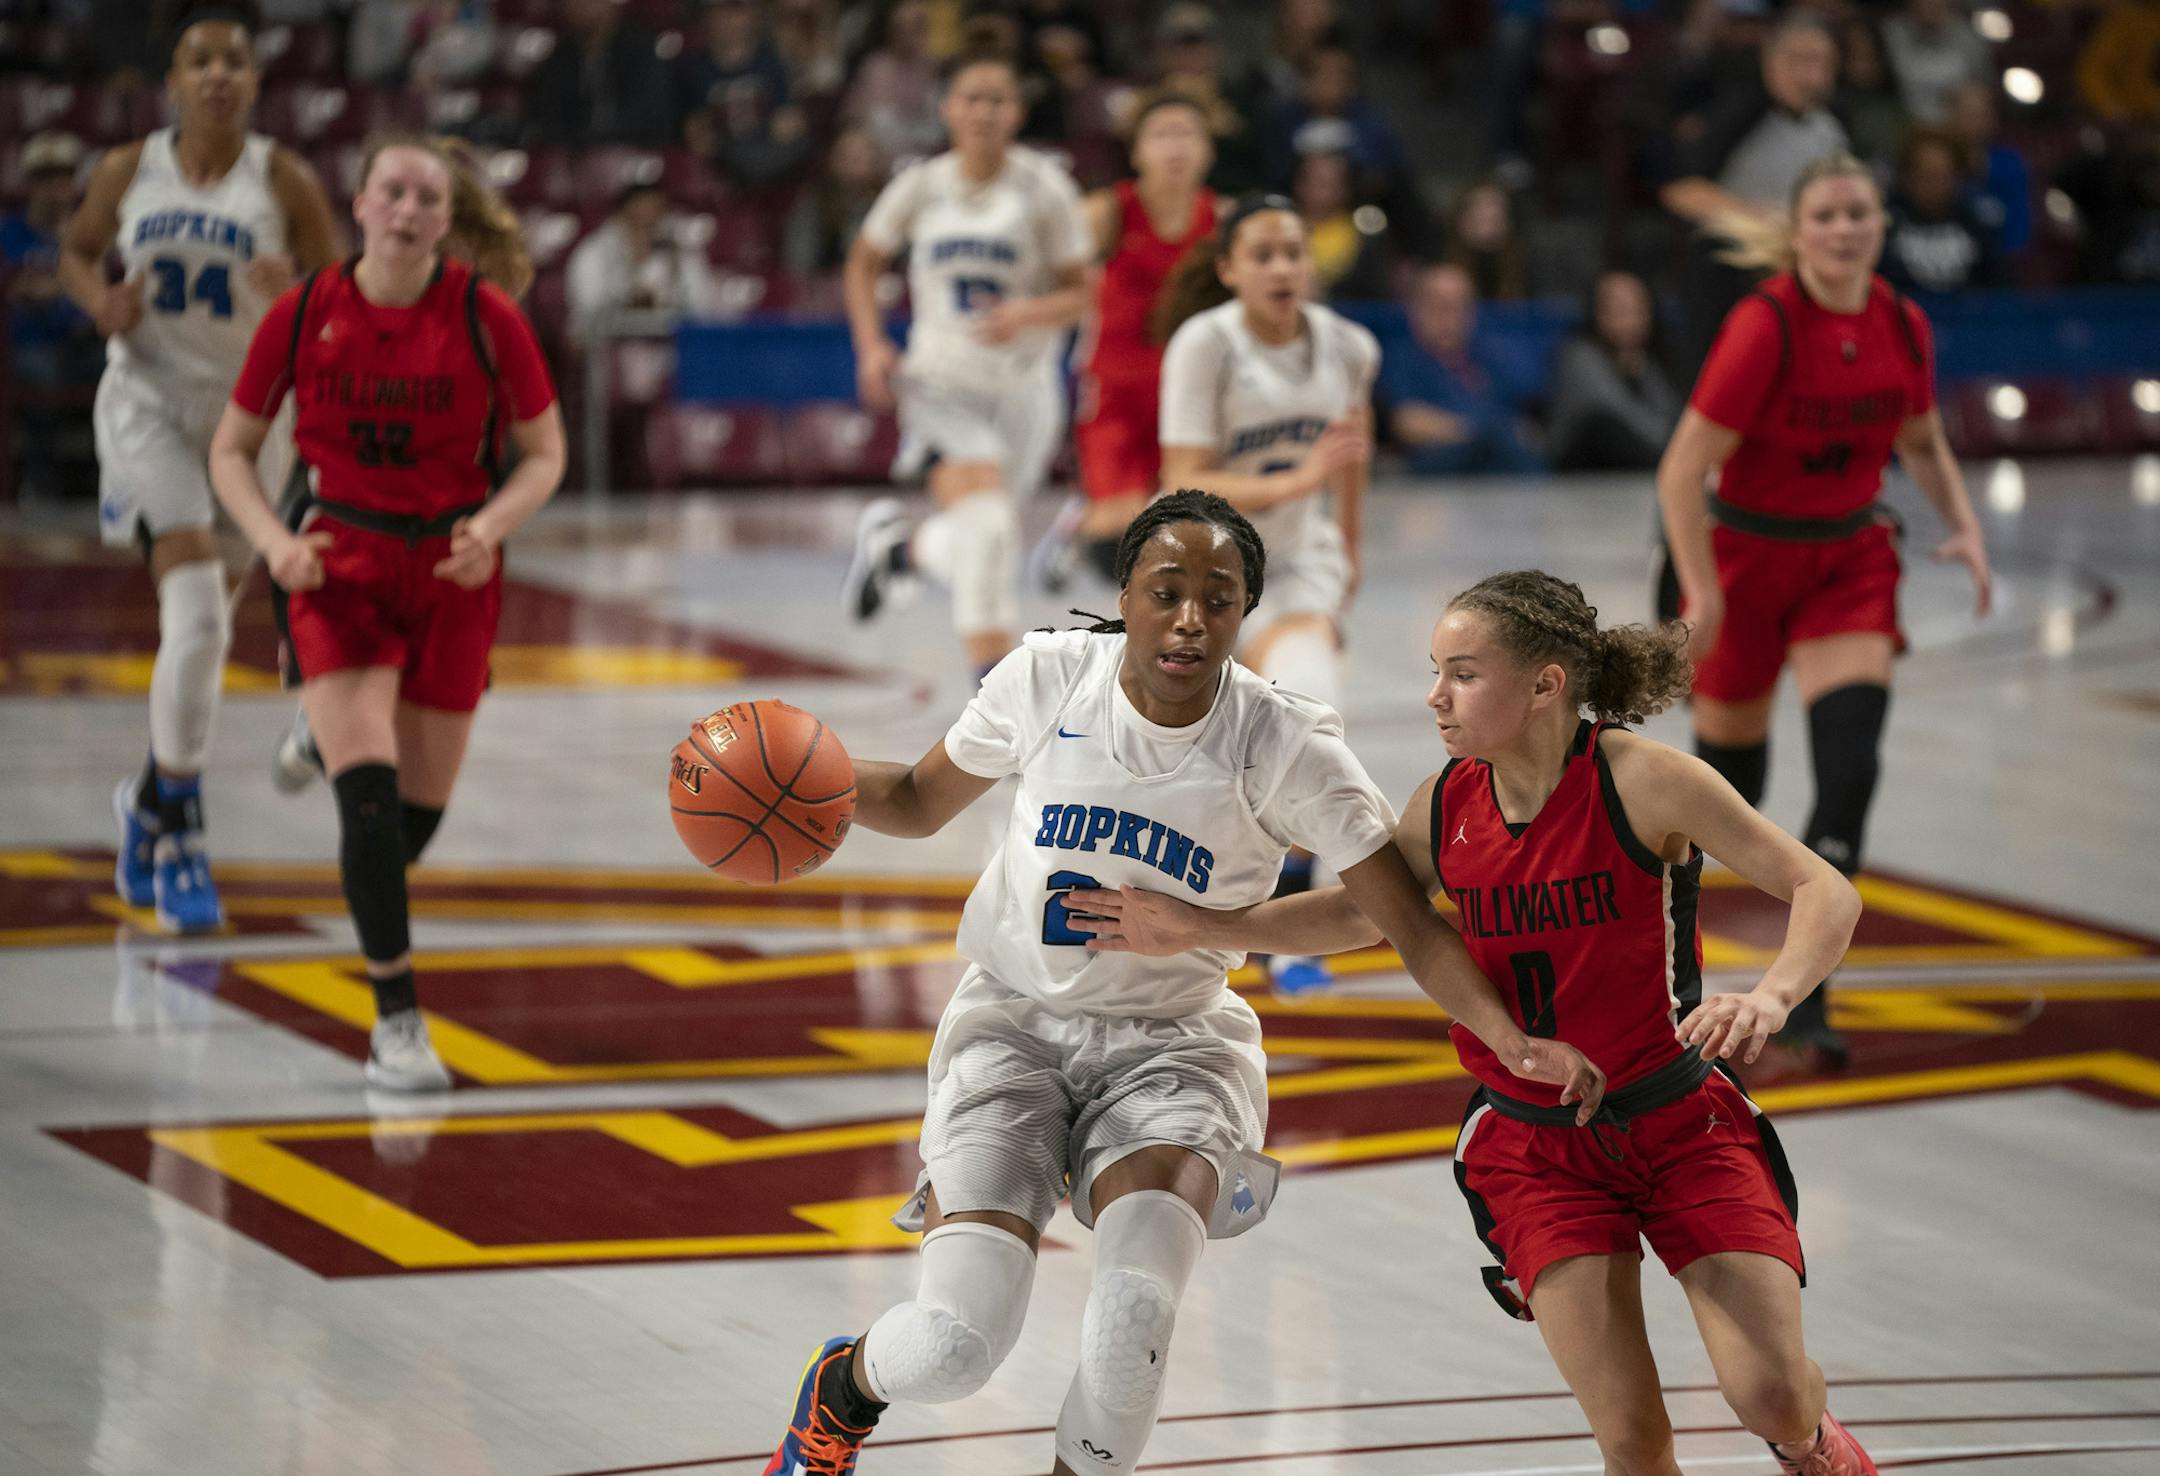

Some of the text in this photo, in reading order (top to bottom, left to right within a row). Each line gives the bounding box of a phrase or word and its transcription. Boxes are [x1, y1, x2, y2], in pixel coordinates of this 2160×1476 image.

[153, 258, 232, 318] 34
[350, 420, 417, 467] 32
[1034, 804, 1215, 895] HOPKINS
[1453, 870, 1621, 939] TILLWATER
[1509, 951, 1557, 1038] 0
